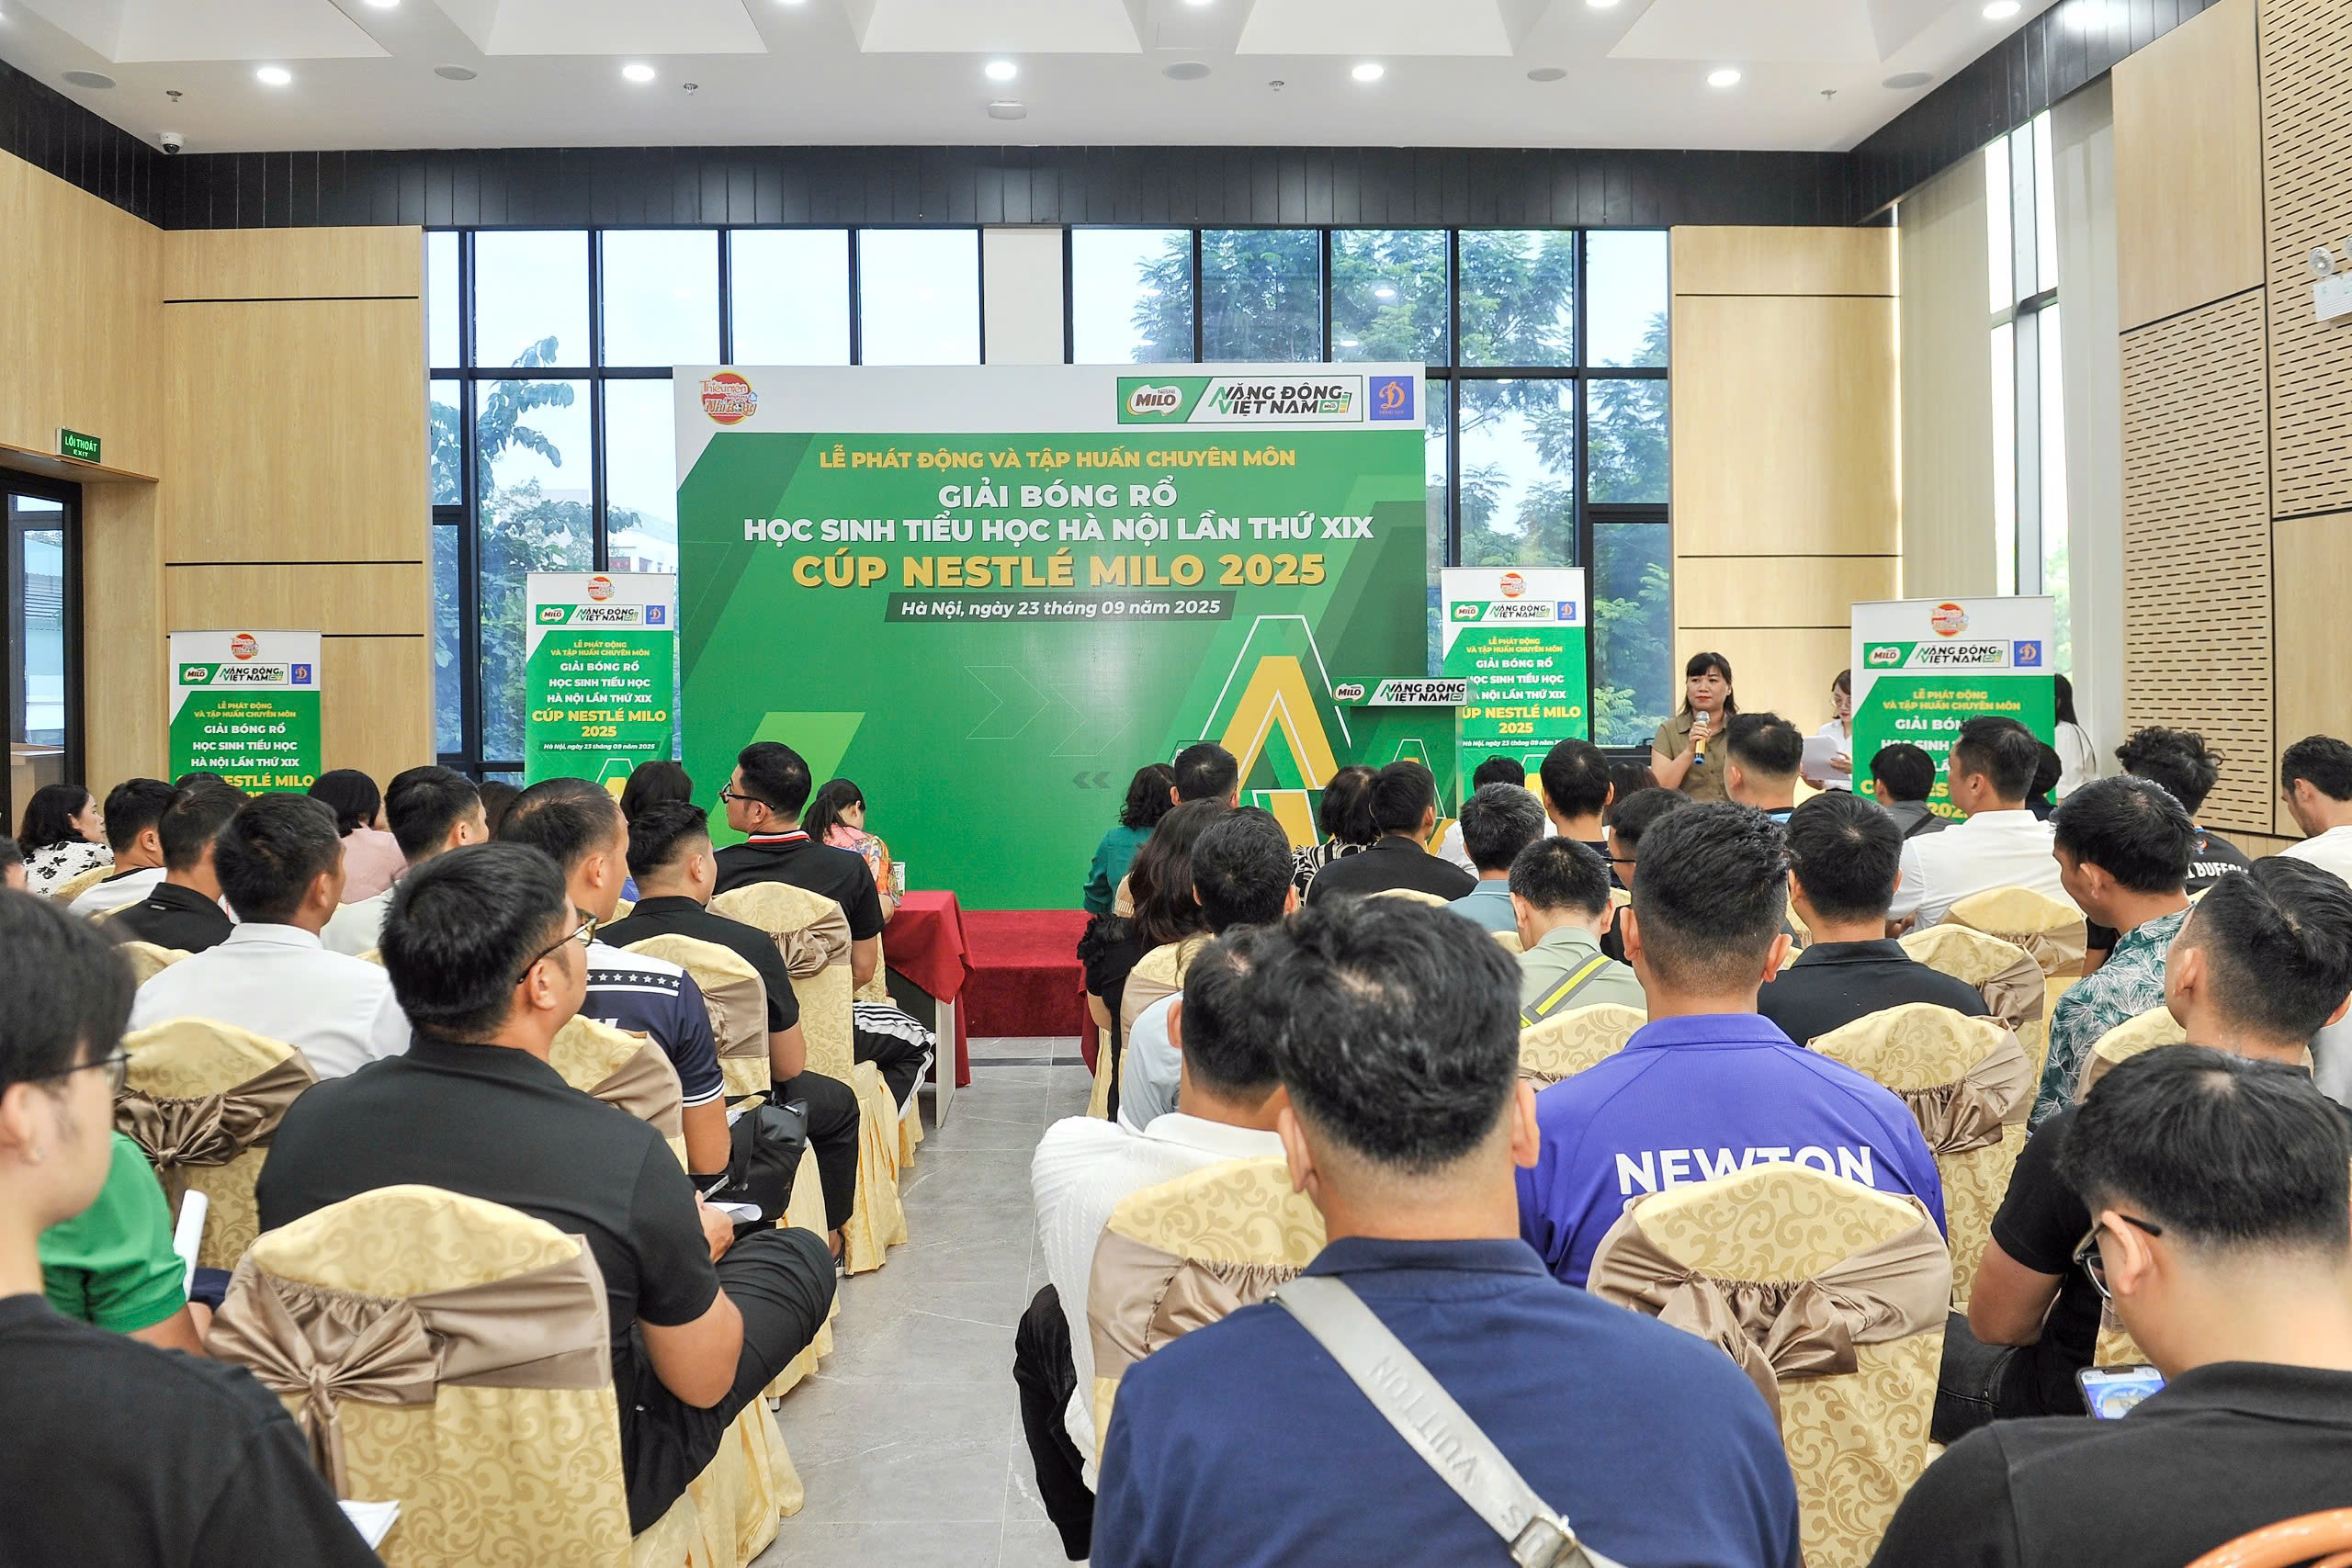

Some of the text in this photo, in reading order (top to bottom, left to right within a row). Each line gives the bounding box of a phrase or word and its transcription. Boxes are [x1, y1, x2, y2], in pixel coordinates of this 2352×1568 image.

[1136, 393, 1176, 407] MILO
[1208, 383, 1276, 407] NĂNG
[1218, 397, 1318, 416] VIỆT NAM
[76, 439, 97, 452] THOÁT
[74, 449, 88, 457] EXIT
[820, 445, 1295, 472] LỄ PHÁT ĐỘNG VÀ TẬP HUẤN CHUYÊN MÔN
[938, 475, 1178, 508] GIẢI BÓNG RỔ
[744, 510, 1374, 548] HỌC SINH TIỂU HỌC HÀ NỘI LẦN THỨ XIX
[792, 547, 1326, 588] CÚP NESTLÉ MILO 2025
[901, 600, 1221, 620] Hà Nội, ngày 23 tháng 09 năm 2025
[560, 660, 583, 671] GIẢI
[587, 661, 620, 671] BÓNG
[1502, 658, 1534, 669] BÓNG
[1951, 655, 1982, 663] NAM
[548, 679, 572, 689] HỌC
[574, 679, 599, 687] SINH
[627, 679, 650, 689] HỌC
[1490, 675, 1514, 683] SINH
[1541, 675, 1565, 685] HỌC
[547, 693, 563, 703] HÀ
[565, 693, 583, 705] NỘI
[634, 694, 652, 703] XIX
[1482, 690, 1499, 701] NỘI
[1548, 691, 1566, 700] XIX
[532, 707, 667, 722] CÚP NESTLÉ MILO
[1485, 704, 1540, 718] NESTLÉ
[1544, 706, 1581, 718] MILO
[232, 723, 266, 734] BÓNG
[1498, 722, 1534, 734] 2025
[1895, 715, 1928, 730] GIẢI
[582, 726, 617, 738] 2025
[193, 742, 217, 752] HỌC
[274, 742, 298, 752] HỌC
[191, 756, 208, 766] HÀ
[209, 757, 229, 769] NỘI
[276, 775, 315, 787] MILO
[1366, 1356, 1479, 1485] VUITTON
